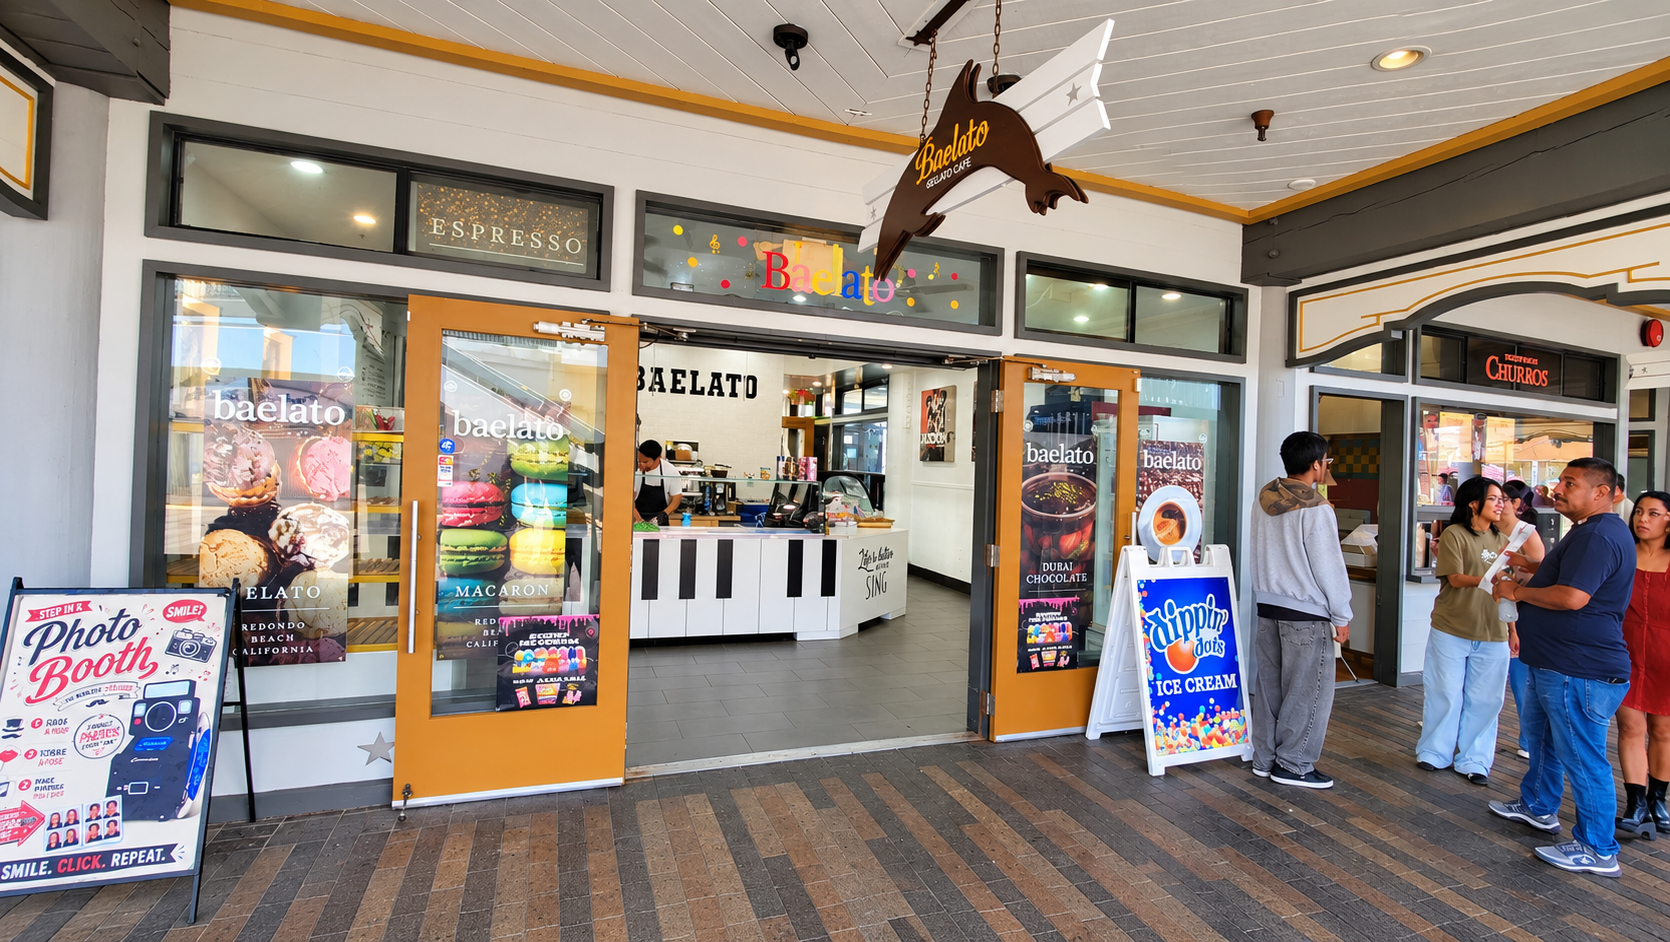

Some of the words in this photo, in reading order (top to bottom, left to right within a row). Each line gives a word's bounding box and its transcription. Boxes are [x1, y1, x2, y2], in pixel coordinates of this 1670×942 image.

[916, 119, 990, 186] Baelato
[431, 217, 583, 254] ESPRESSO
[760, 244, 896, 306] Baelato
[637, 365, 758, 399] BAELATO
[1485, 355, 1549, 387] CHURROS
[212, 389, 345, 425] baelato
[452, 410, 564, 441] baelato
[1026, 442, 1094, 465] baelato
[1143, 449, 1202, 470] baelato
[245, 586, 321, 600] ELATO
[455, 584, 550, 597] MACARON
[865, 571, 887, 600] SING
[1026, 573, 1089, 584] CHOCOLATE
[39, 606, 62, 620] STEP
[242, 621, 305, 631] REDONDO
[24, 608, 143, 667] Photo
[251, 634, 294, 643] BEACH
[1193, 636, 1225, 658] dots
[25, 637, 158, 705] Booth
[1156, 679, 1182, 696] ICE
[1185, 674, 1238, 693] CREAM
[1, 861, 53, 880] SMILE.
[57, 855, 106, 873] CLICK.
[111, 848, 165, 867] REPEAT.
